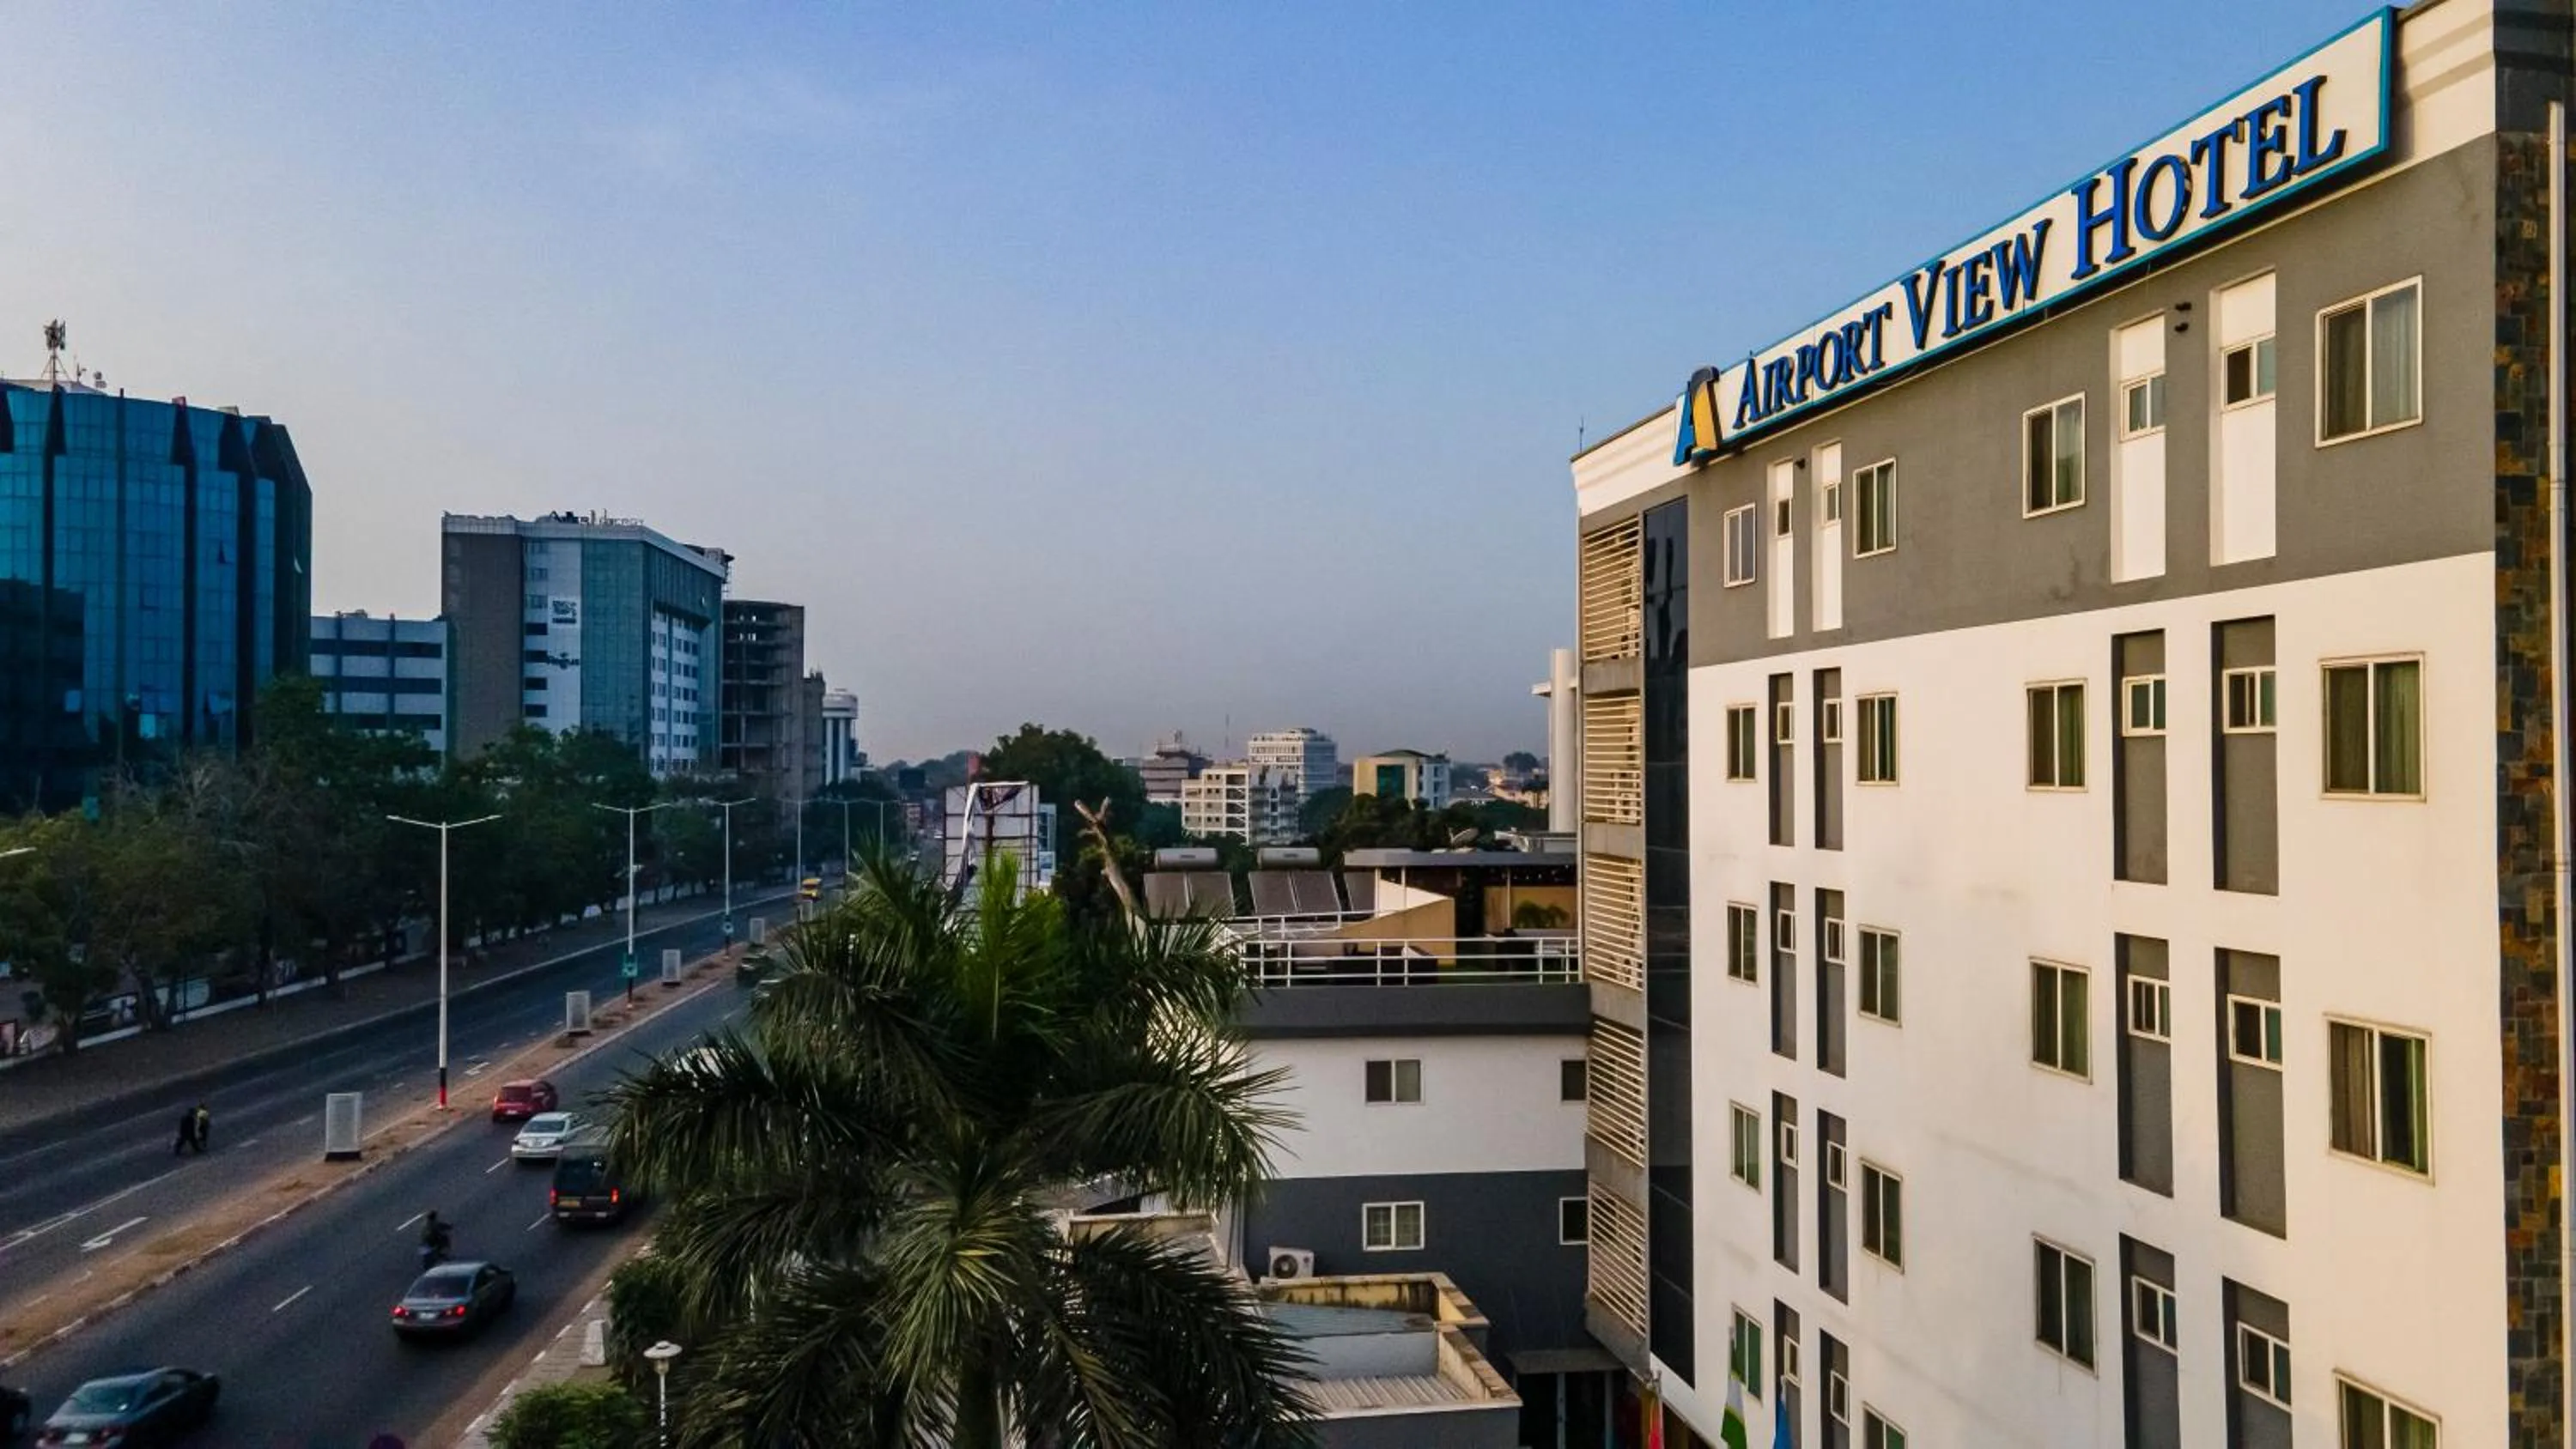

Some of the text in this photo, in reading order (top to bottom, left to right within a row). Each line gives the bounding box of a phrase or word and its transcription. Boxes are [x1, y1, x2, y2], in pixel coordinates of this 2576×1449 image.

[1732, 75, 2347, 429] AIRPORT VIEW HOTEL
